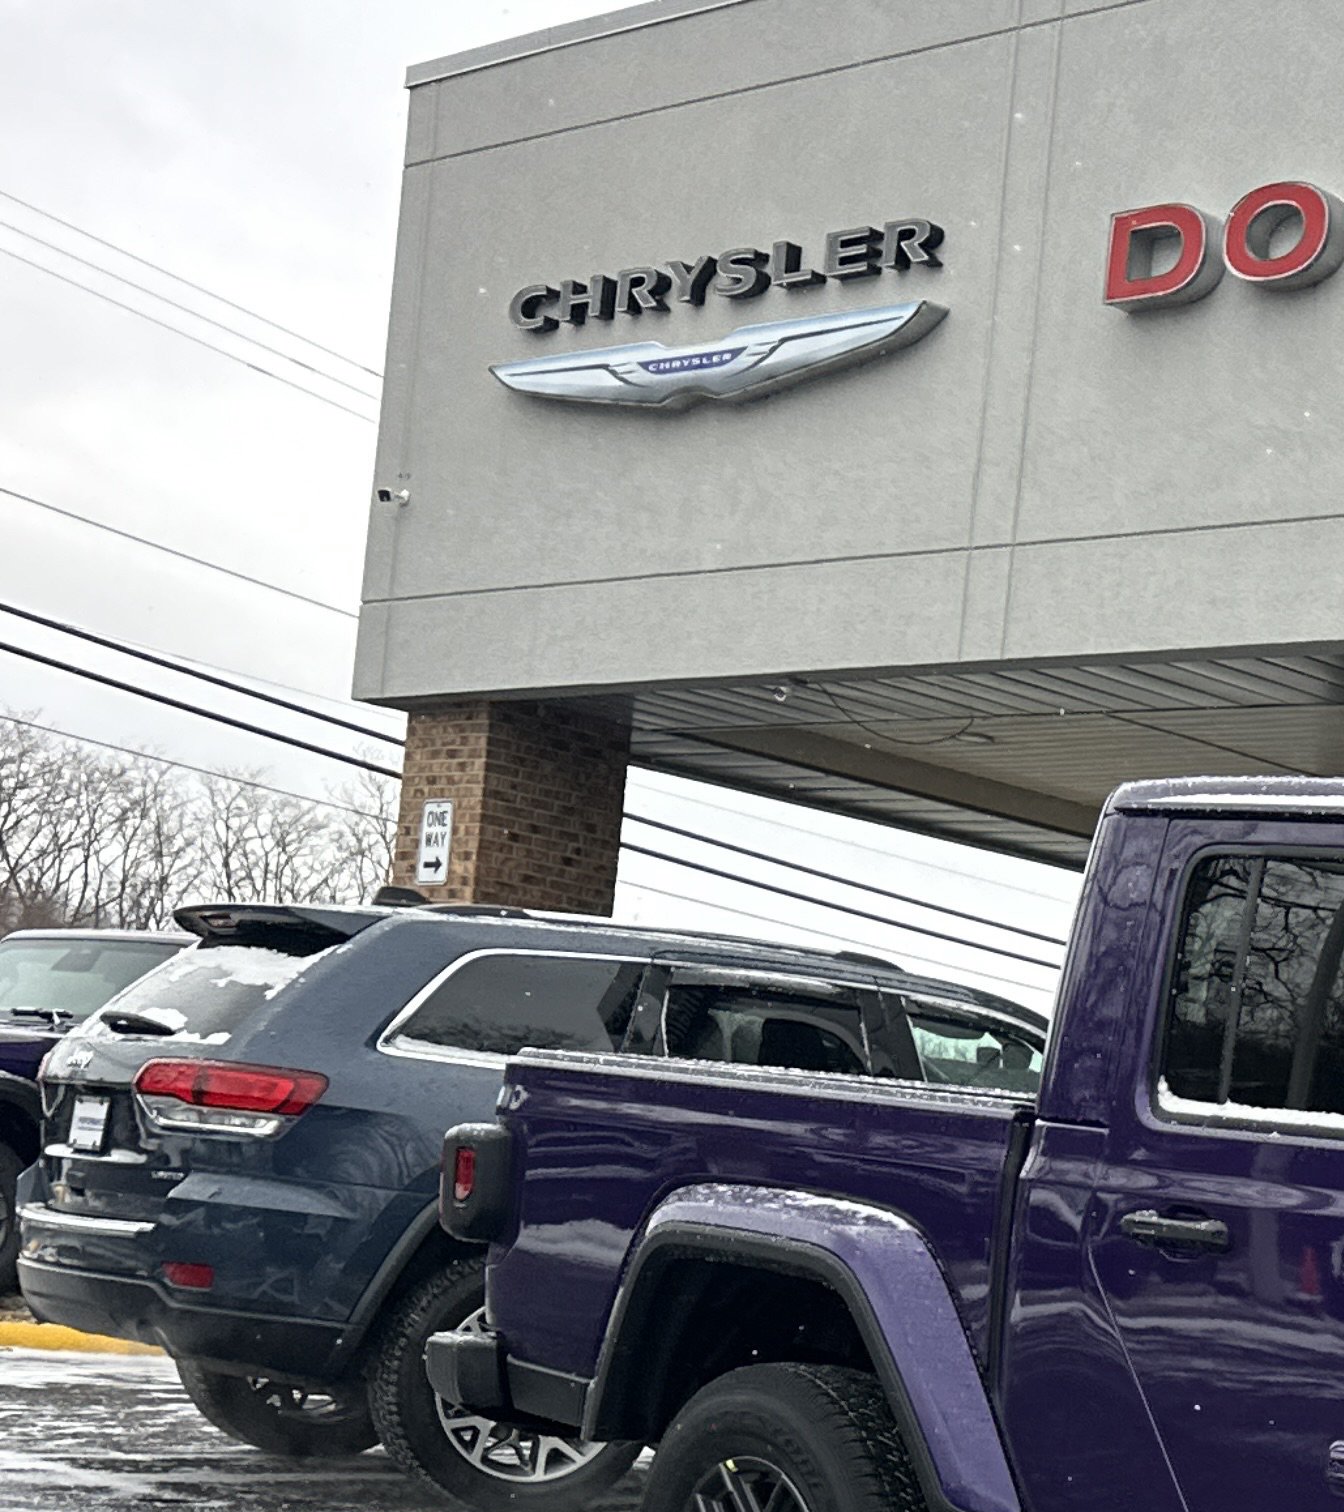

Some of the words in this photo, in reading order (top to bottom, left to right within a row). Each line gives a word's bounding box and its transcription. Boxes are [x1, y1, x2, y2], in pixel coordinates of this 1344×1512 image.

[508, 216, 946, 335] CHRYSLER
[648, 352, 733, 372] CHRYSLER
[426, 810, 449, 828] ONE
[425, 831, 448, 848] WAY
